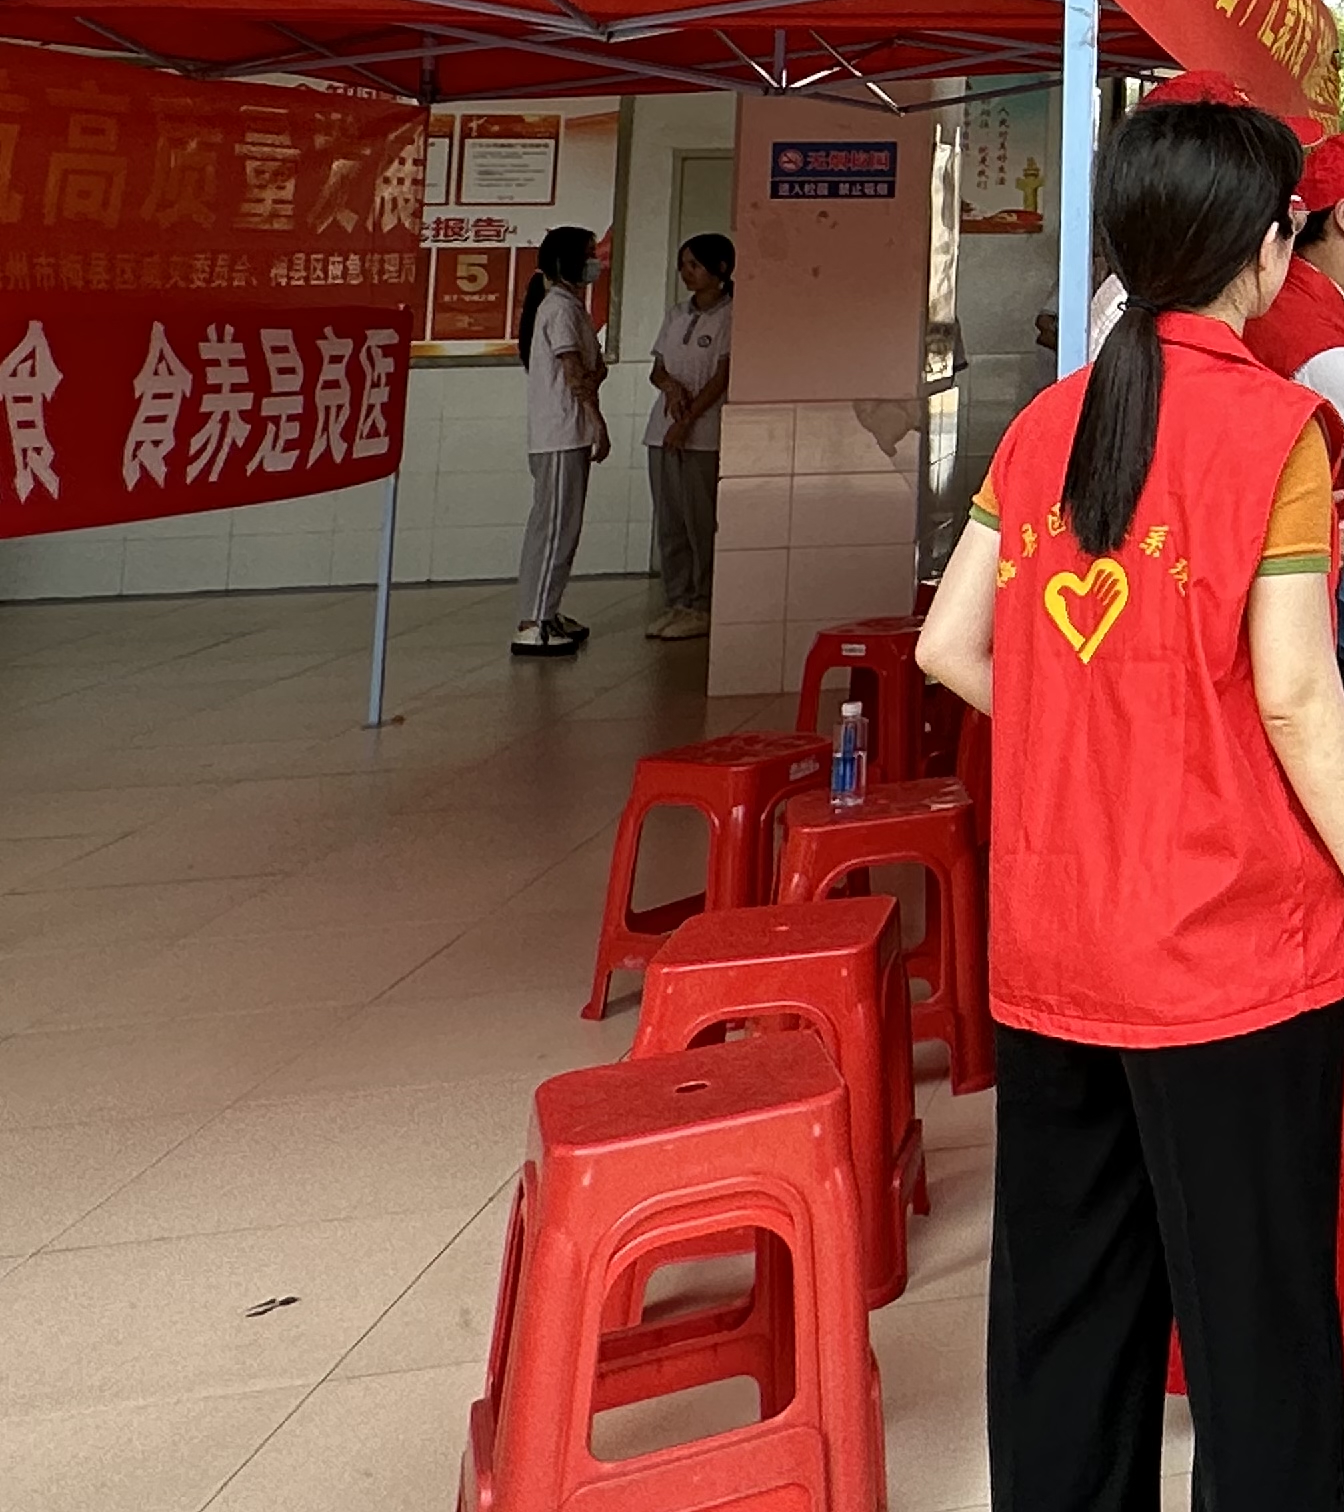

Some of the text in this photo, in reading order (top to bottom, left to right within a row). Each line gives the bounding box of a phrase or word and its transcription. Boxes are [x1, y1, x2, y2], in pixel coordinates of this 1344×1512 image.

[422, 217, 508, 243] 报告
[456, 254, 489, 293] 5
[122, 320, 399, 492] 食养是良医
[998, 502, 1190, 597] 梅县区系统
